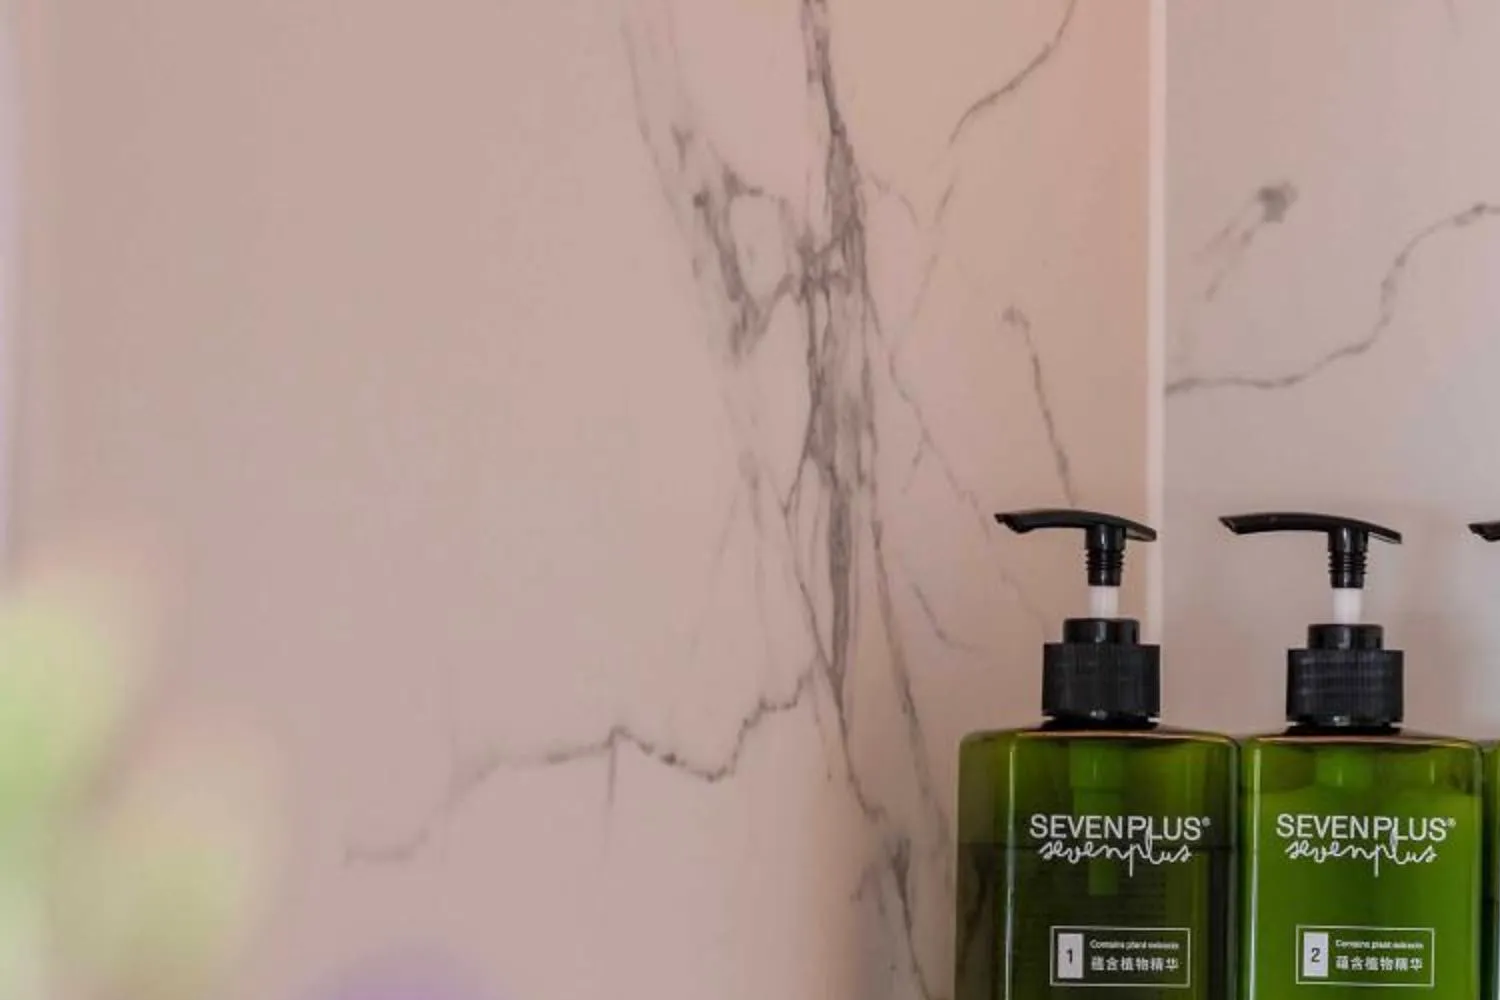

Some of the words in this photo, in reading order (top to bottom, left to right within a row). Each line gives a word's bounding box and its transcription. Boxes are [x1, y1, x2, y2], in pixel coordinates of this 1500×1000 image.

[1039, 826, 1193, 878] sevenplus
[1285, 826, 1438, 878] sevenplus
[1066, 948, 1074, 965] 1
[1310, 947, 1321, 964] 2
